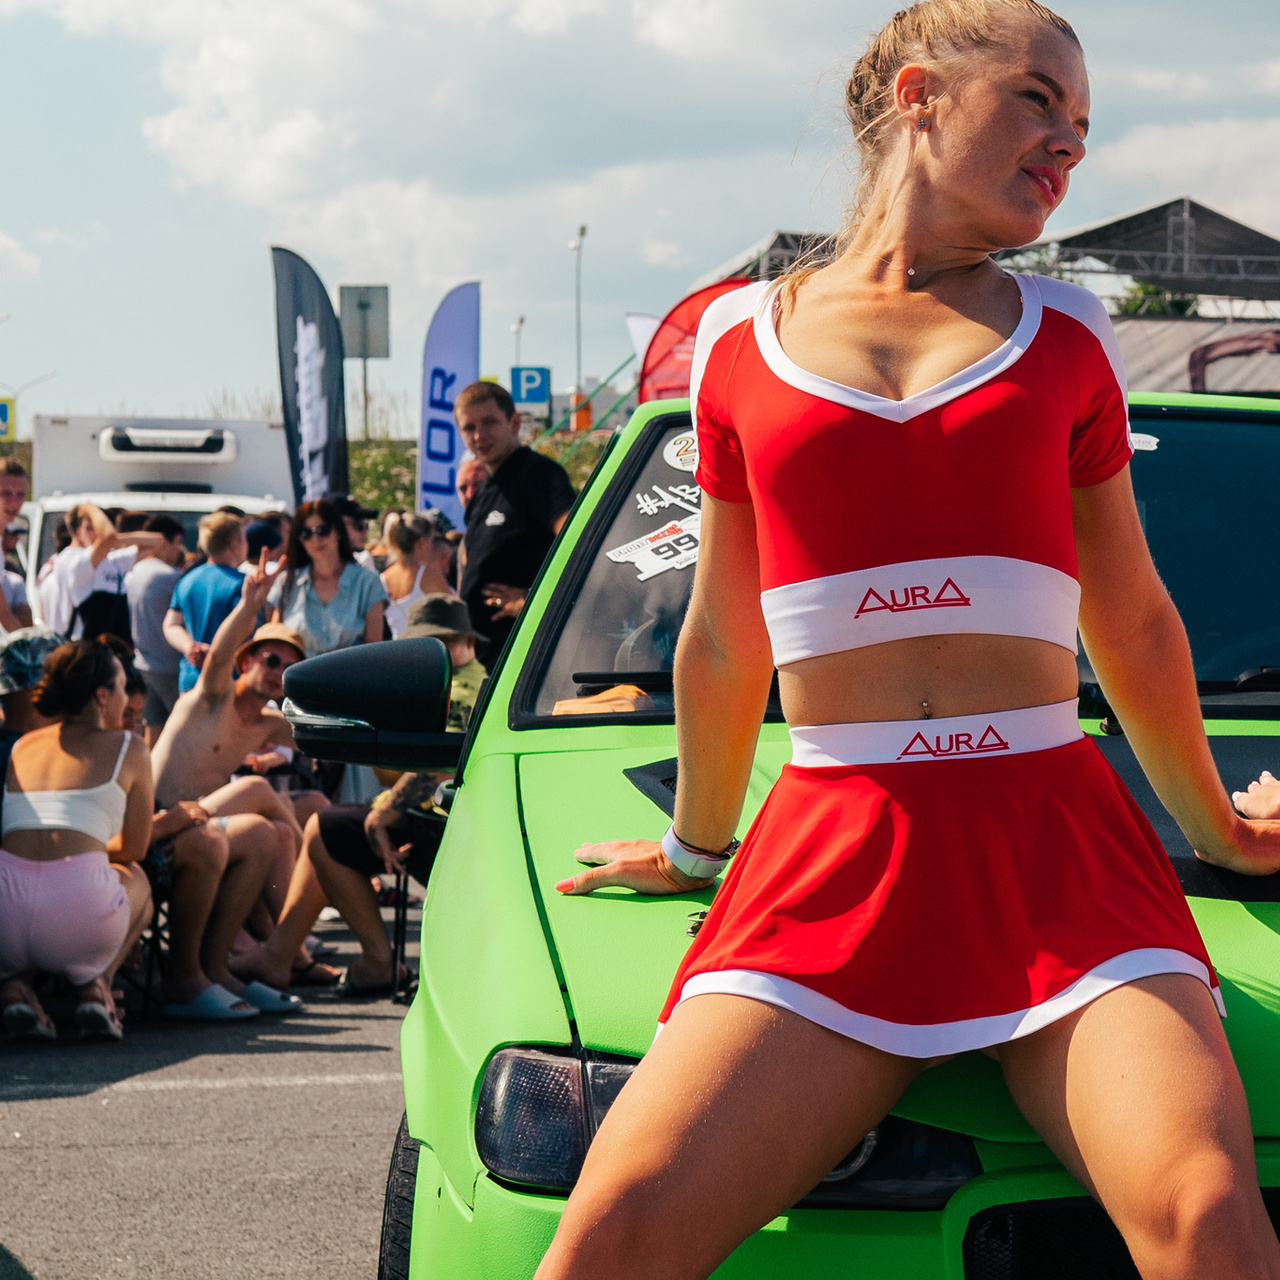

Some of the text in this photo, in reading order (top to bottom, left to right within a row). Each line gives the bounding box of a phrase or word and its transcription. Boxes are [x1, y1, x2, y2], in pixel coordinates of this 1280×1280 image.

[521, 370, 541, 399] P
[422, 367, 456, 509] LOR
[673, 437, 697, 456] 2
[651, 533, 699, 560] 99
[854, 577, 971, 619] AURA
[896, 724, 1010, 760] AURA
